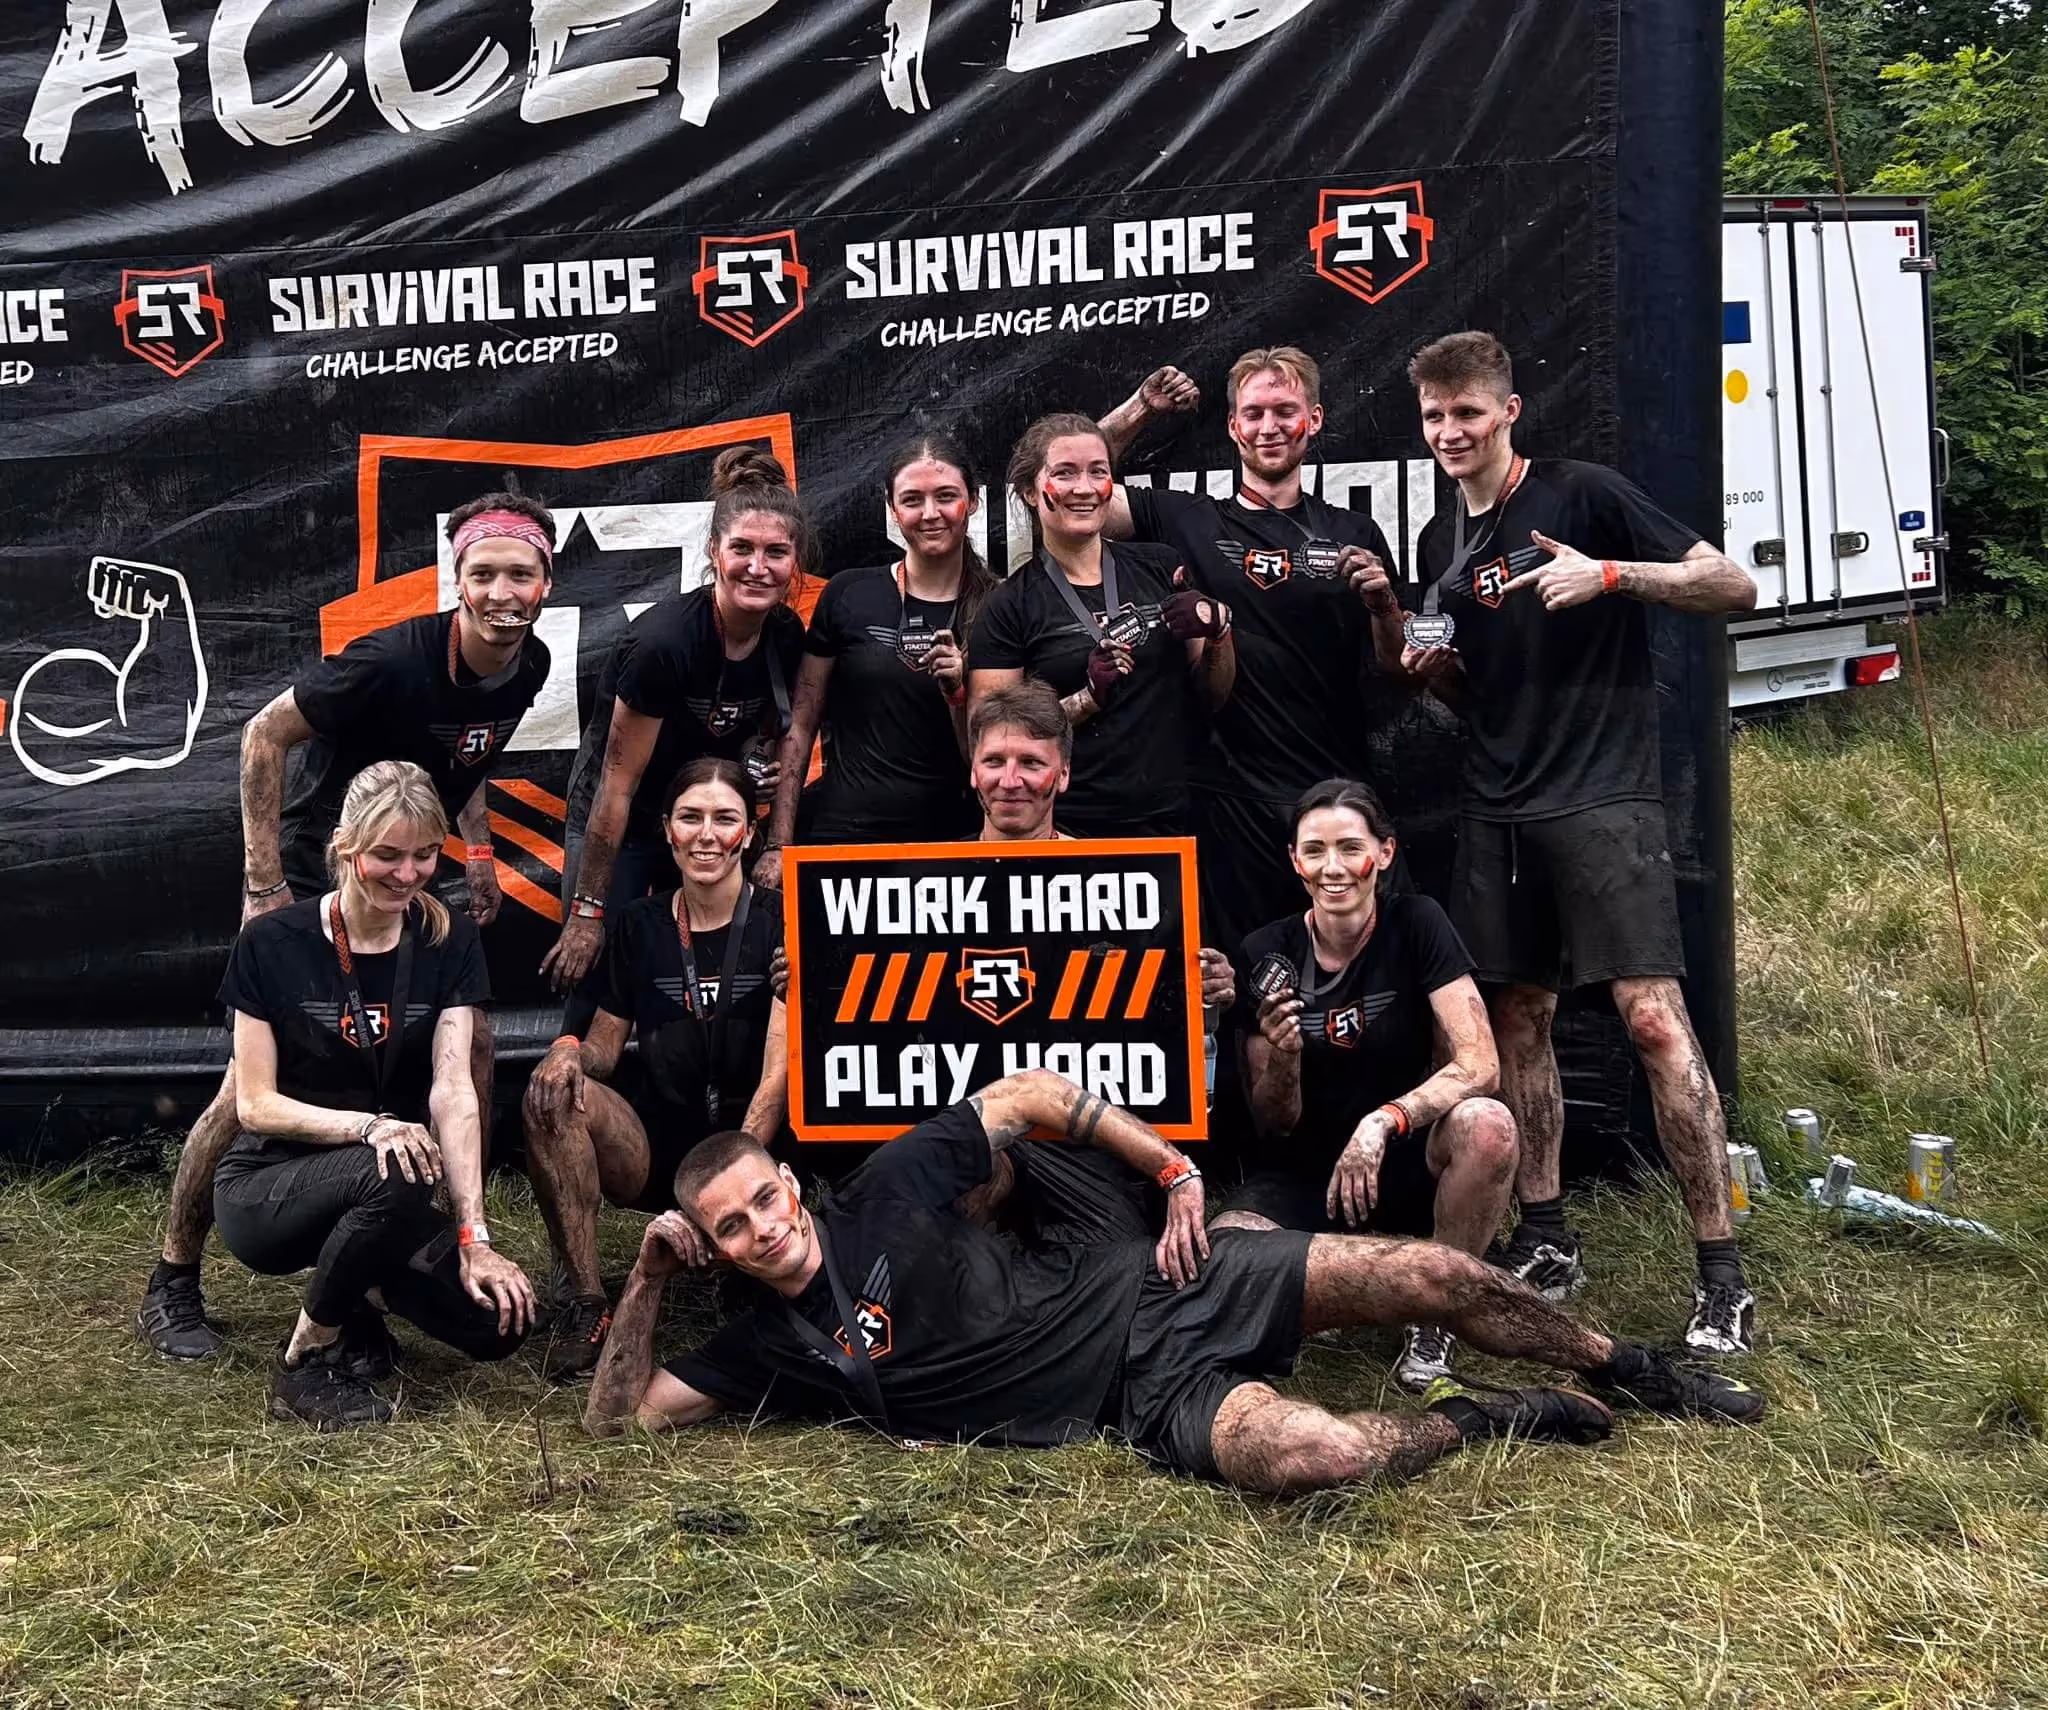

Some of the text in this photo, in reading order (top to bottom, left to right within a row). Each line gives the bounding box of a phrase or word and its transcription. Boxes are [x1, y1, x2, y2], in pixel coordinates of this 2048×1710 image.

[1114, 213, 1254, 278] RACE
[1334, 201, 1409, 262] SR
[524, 257, 656, 318] RACE
[716, 249, 785, 307] SR
[0, 289, 68, 343] CE
[138, 283, 206, 337] SR
[881, 292, 1210, 347] CHALLENGE ACCEPTED
[307, 332, 618, 379] CHALLENGE ACCEPTED
[1743, 490, 1764, 504] 000
[1252, 553, 1283, 577] SR
[464, 729, 488, 752] SR
[821, 872, 1160, 934] WORK HARD
[972, 960, 1020, 998] SR
[1336, 1008, 1360, 1038] SR
[825, 1043, 980, 1107] PLAY
